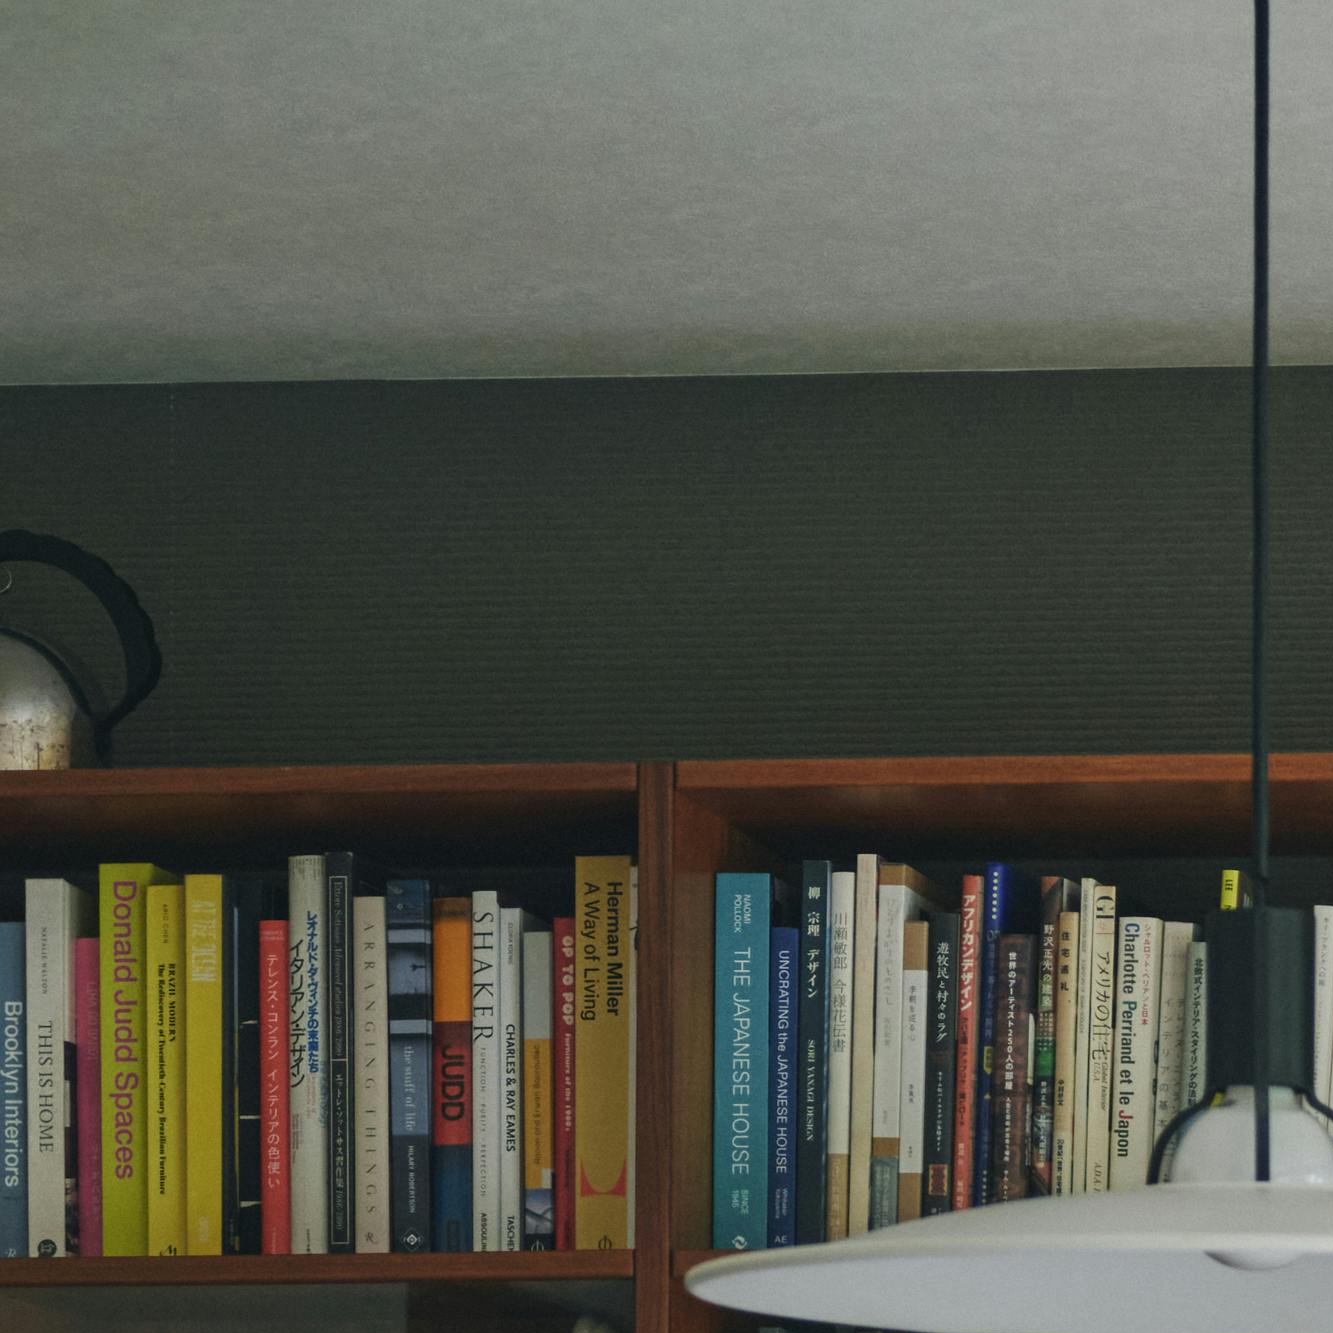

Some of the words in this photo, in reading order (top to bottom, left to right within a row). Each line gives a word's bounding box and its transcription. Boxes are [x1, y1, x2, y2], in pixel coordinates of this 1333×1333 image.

[584, 882, 599, 896] A
[743, 894, 751, 924] NAOMI
[113, 880, 137, 982] Donald
[580, 898, 599, 940] Way
[607, 882, 622, 956] Herman
[734, 894, 742, 933] POLLOCK
[158, 964, 166, 977] The
[473, 911, 494, 1042] SHAKER
[584, 944, 600, 962] of
[733, 947, 751, 987] THE
[1123, 923, 1140, 994] Charlotte
[157, 980, 166, 1026] Rediscovery
[363, 921, 377, 1089] ARRANGING
[581, 967, 600, 1021] Living
[607, 962, 622, 1015] Miller
[776, 950, 791, 1028] UNCRATING
[2, 1001, 22, 1096] Brooklyn
[38, 1020, 53, 1067] THIS
[113, 990, 137, 1063] Judd
[158, 1029, 166, 1037] of
[505, 1024, 516, 1075] CHARLES
[732, 993, 751, 1095] JAPANESE
[777, 1032, 789, 1052] the
[1120, 1000, 1137, 1065] Perriand
[39, 1072, 53, 1088] IS
[440, 1045, 465, 1121] JUDD
[506, 1078, 516, 1086] &
[506, 1090, 516, 1111] RAY
[776, 1055, 789, 1123] JAPANESE
[1120, 1070, 1134, 1084] et
[1120, 1091, 1134, 1105] le
[4, 1099, 22, 1187] Interiors
[38, 1094, 54, 1153] HOME
[111, 1072, 139, 1179] Spaces
[506, 1114, 516, 1152] EAMES
[731, 1103, 750, 1175] HOUSE
[1116, 1110, 1134, 1157] Japon
[363, 1105, 377, 1214] THINGS
[775, 1127, 788, 1173] HOUSE
[159, 1157, 167, 1195] Furniture
[408, 1171, 416, 1213] ROBERTSON
[740, 1190, 749, 1215] SINCE
